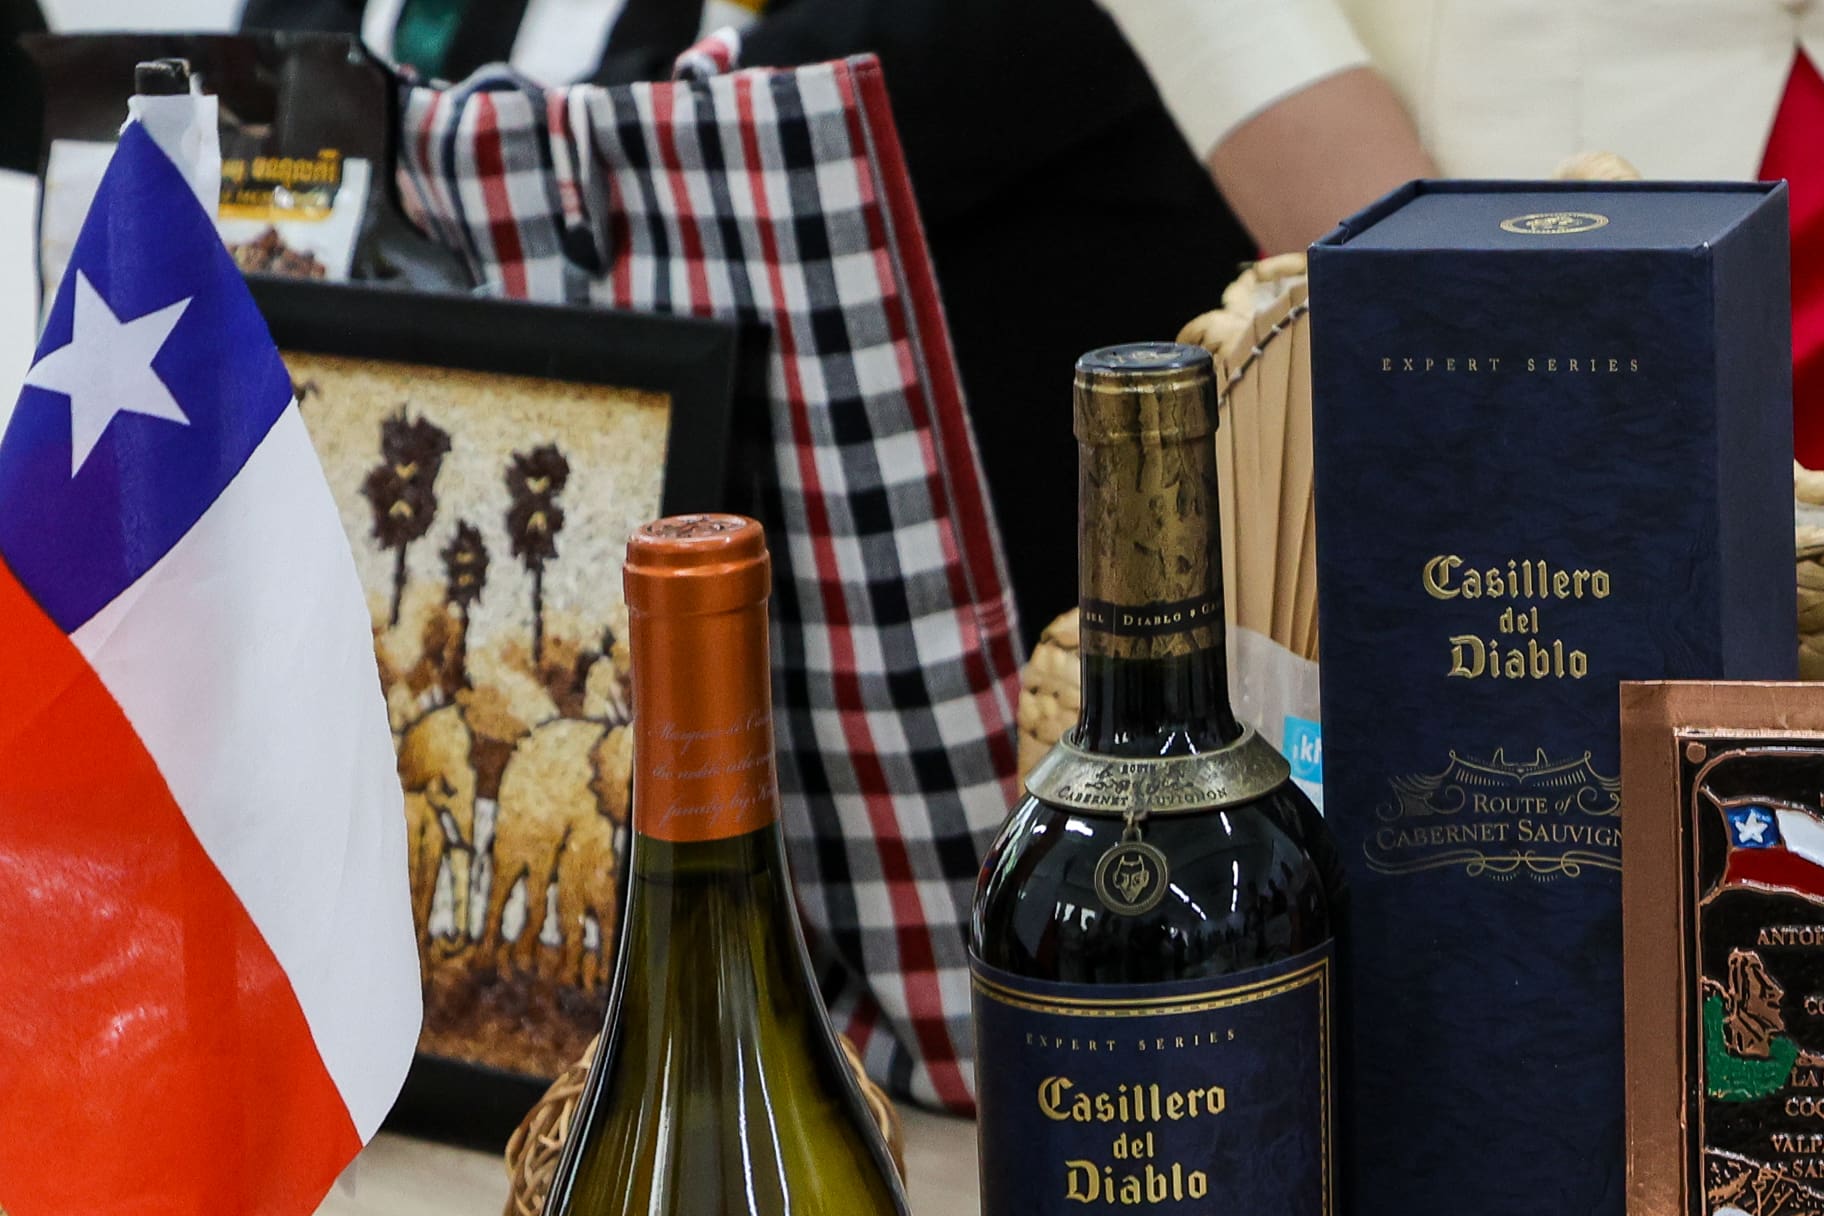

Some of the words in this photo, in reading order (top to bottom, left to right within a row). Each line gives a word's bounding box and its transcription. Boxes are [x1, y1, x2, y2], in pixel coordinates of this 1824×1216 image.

[1381, 358, 1500, 372] EXPERT
[1527, 358, 1639, 373] SERIES
[1422, 554, 1610, 599] Casillero
[1500, 606, 1539, 634] del
[1448, 635, 1588, 679] Diablo
[1473, 794, 1548, 815] ROUTE
[1376, 823, 1509, 850] CABERNET
[1026, 1032, 1116, 1051] EXPERT
[1138, 1029, 1236, 1051] SERIES
[1791, 1067, 1818, 1088] LA
[1037, 1075, 1227, 1122] Casillero
[1113, 1131, 1154, 1159] del
[1065, 1160, 1208, 1205] Diablo
